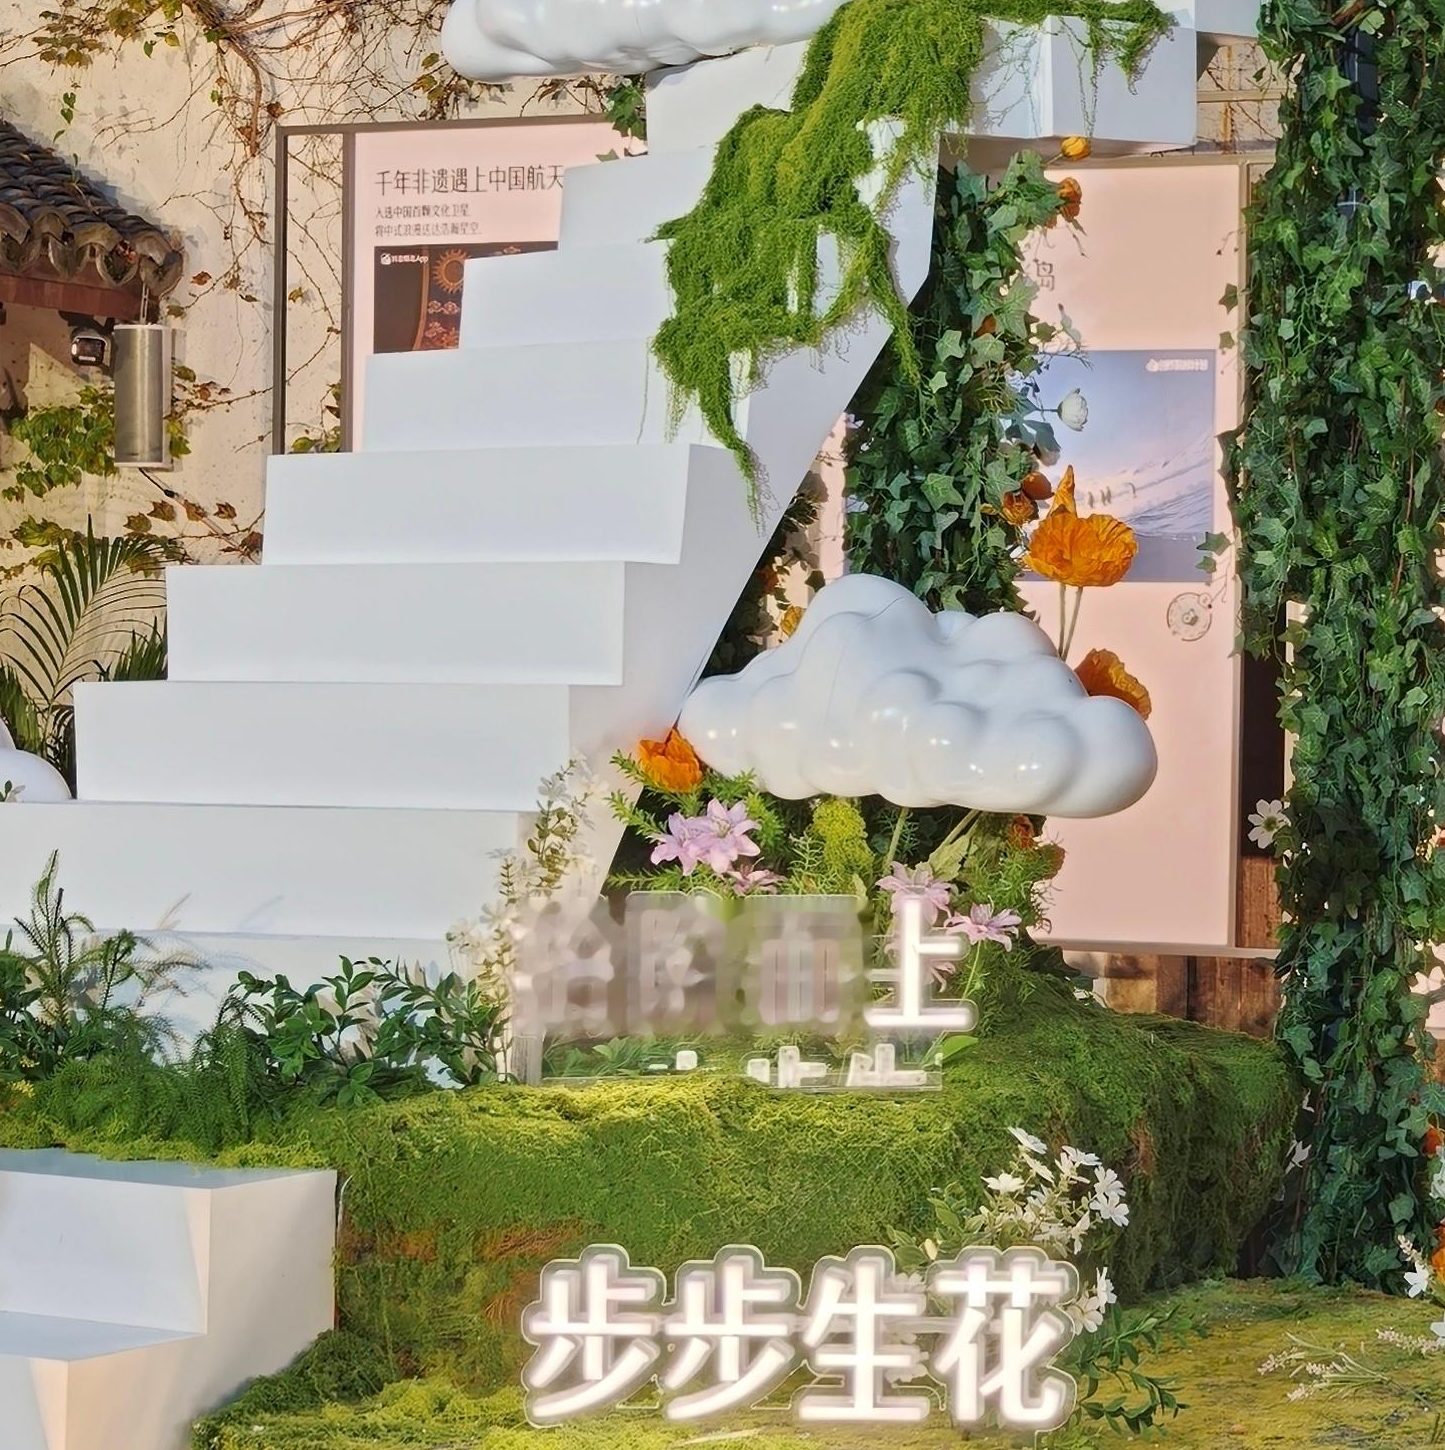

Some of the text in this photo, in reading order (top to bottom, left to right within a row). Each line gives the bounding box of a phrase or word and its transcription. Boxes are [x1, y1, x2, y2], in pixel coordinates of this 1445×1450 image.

[374, 164, 564, 197] 千年非遗遇上中国航天
[528, 1251, 1071, 1425] 步步生花
